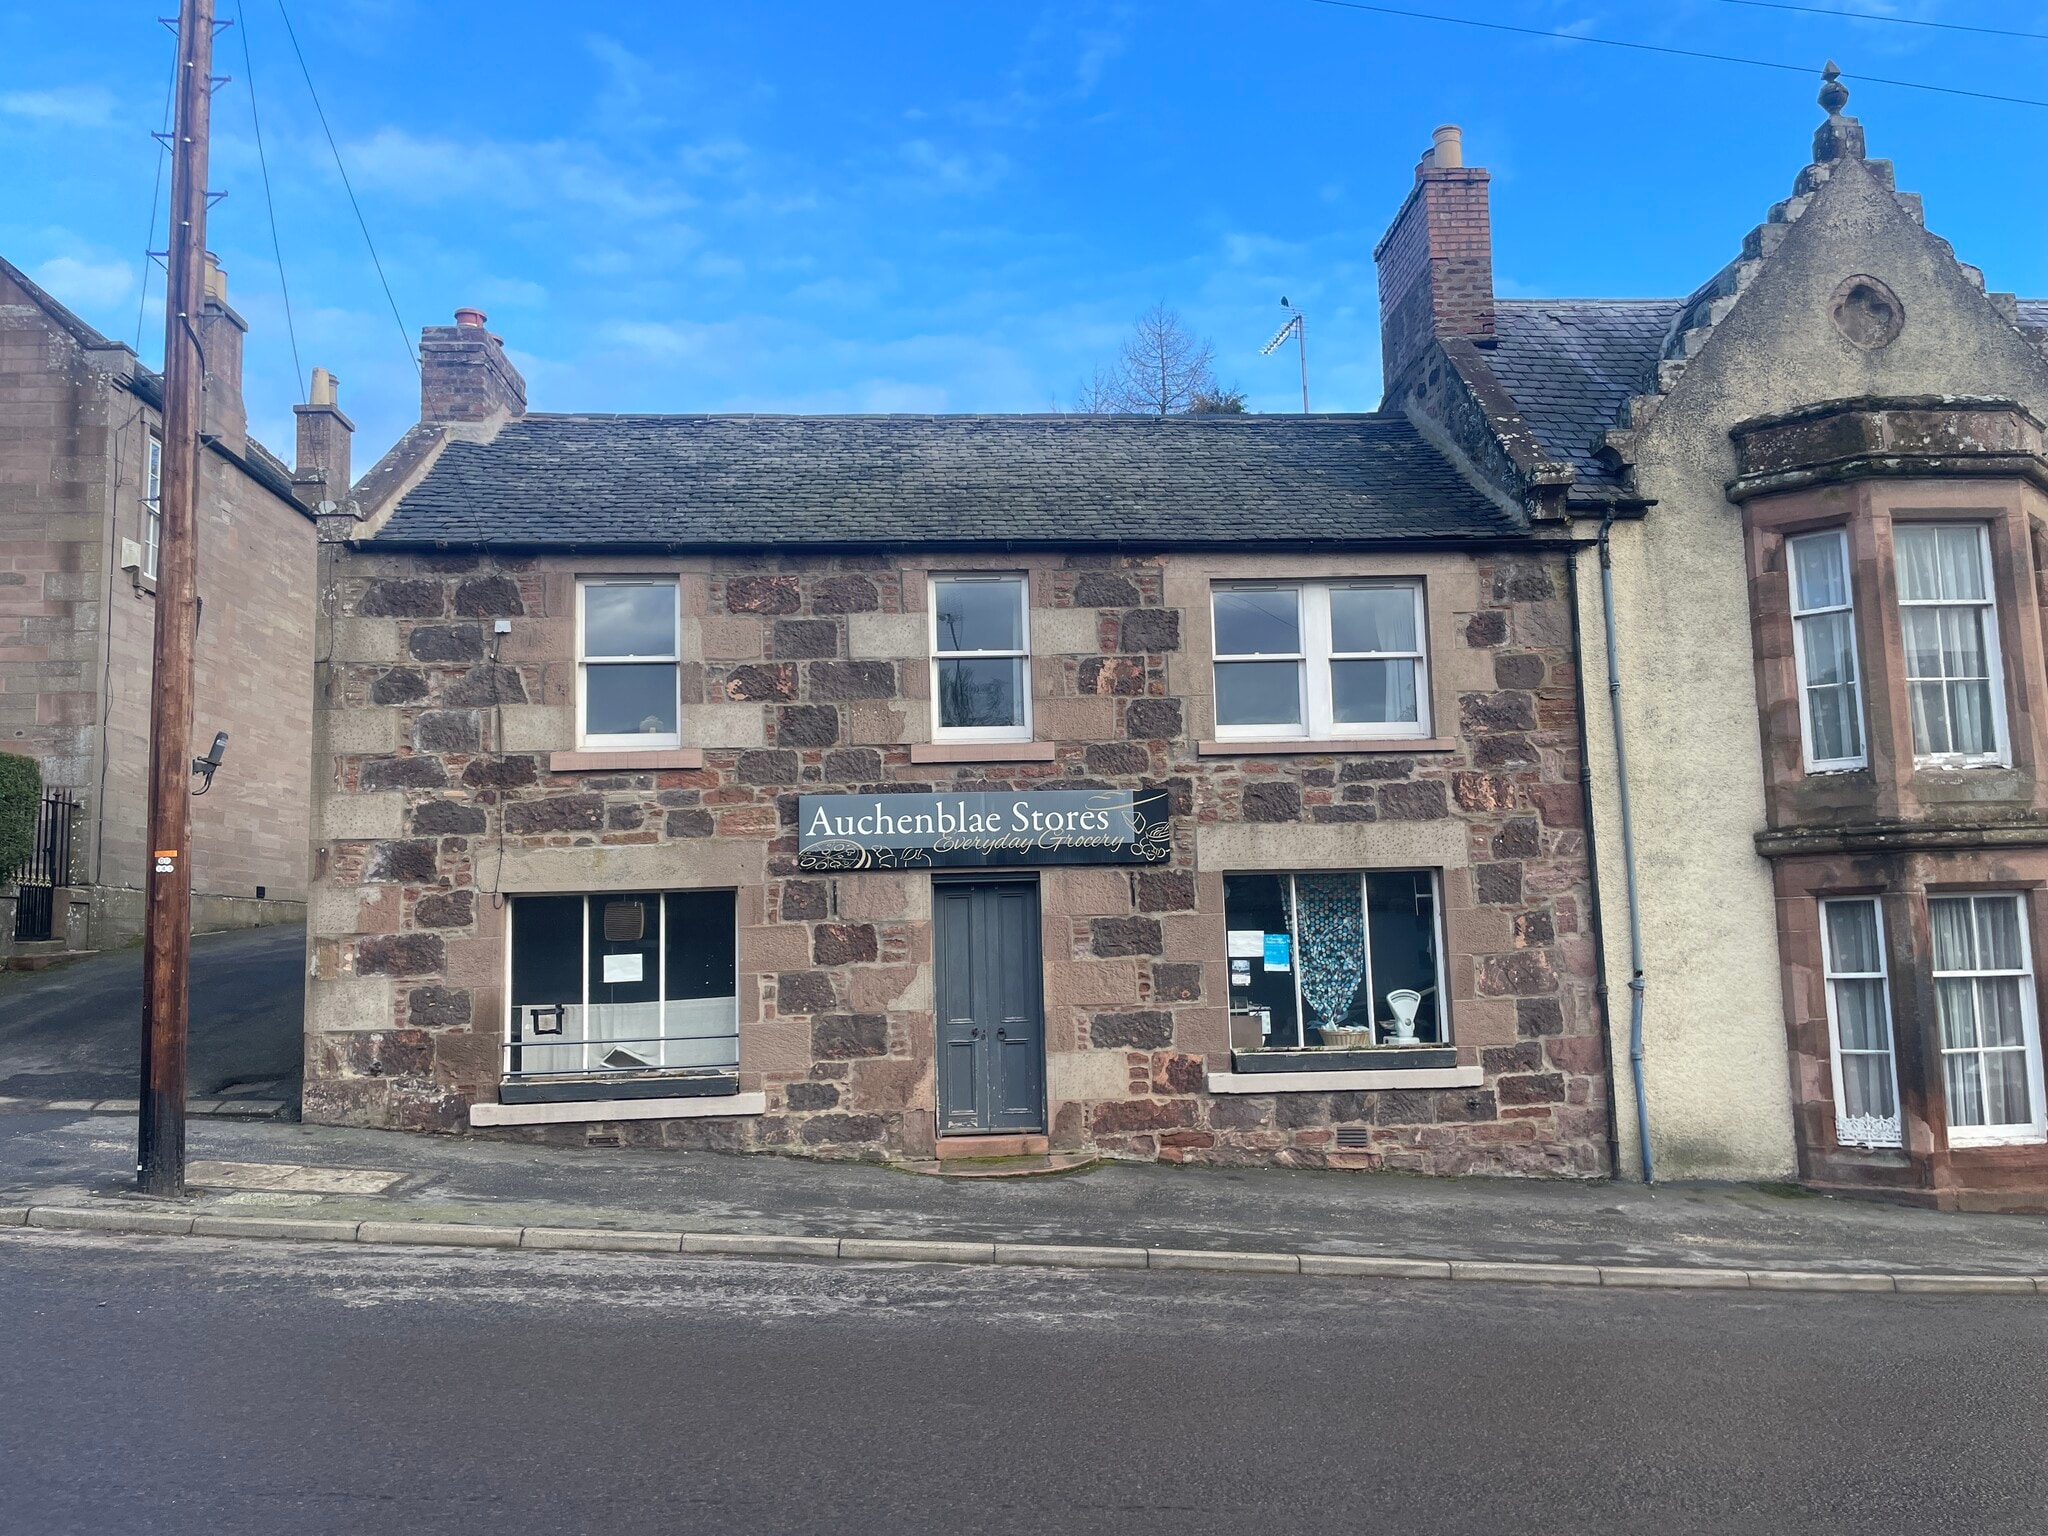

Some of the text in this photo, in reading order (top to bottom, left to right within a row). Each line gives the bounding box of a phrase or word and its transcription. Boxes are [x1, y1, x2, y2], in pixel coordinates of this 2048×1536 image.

[805, 801, 1109, 837] Auchenblae Stores
[932, 828, 1126, 854] Everyday Grocery
